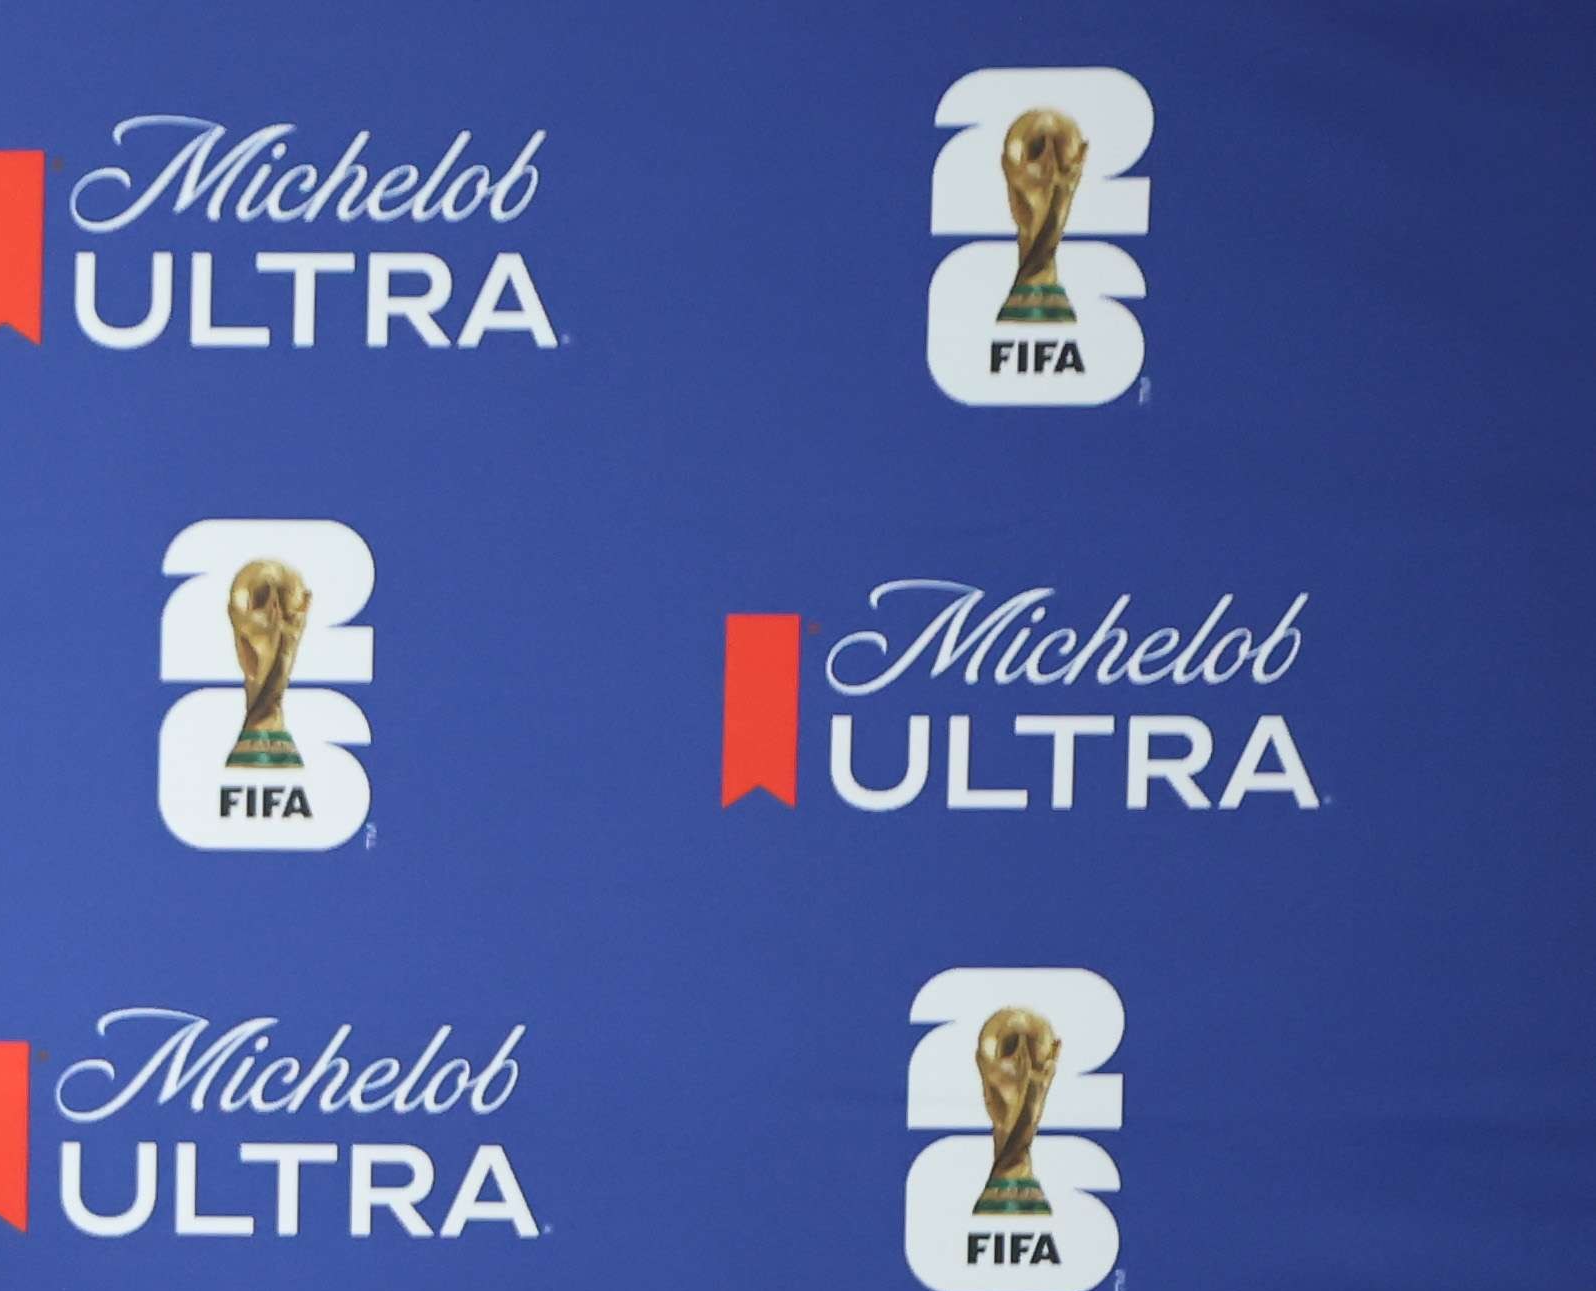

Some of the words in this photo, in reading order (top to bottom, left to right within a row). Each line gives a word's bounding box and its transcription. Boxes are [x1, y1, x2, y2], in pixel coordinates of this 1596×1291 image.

[71, 115, 546, 232] Michelob
[75, 251, 558, 349] ULTRA
[991, 342, 1084, 373] FIFA
[824, 579, 1308, 695] Michelob
[221, 787, 311, 817] FIFA
[830, 715, 1320, 812] ULTRA
[56, 1008, 525, 1122] Michelob
[60, 1141, 539, 1238] ULTRA
[968, 1234, 1060, 1264] FIFA
